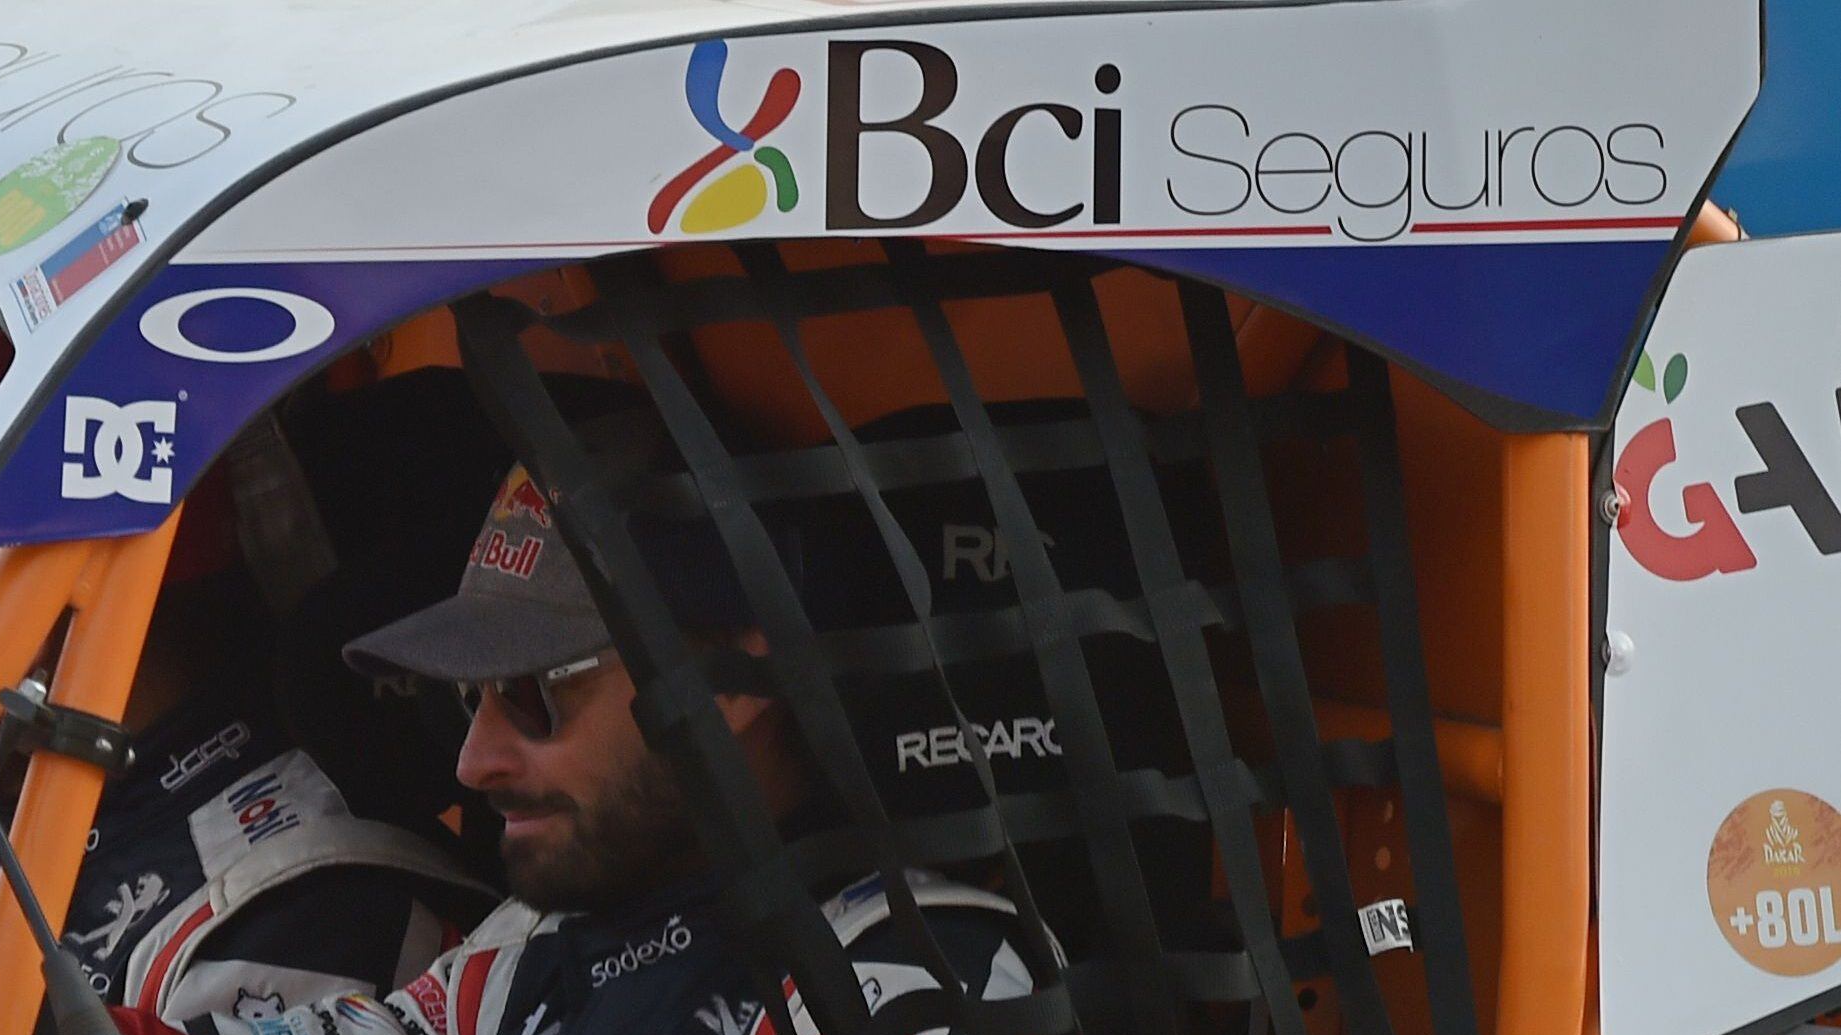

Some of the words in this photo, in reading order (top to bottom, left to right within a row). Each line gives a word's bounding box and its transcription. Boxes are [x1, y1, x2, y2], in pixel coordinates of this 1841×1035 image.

[826, 39, 1121, 230] Bci
[1167, 105, 1666, 242] Seguros
[61, 395, 177, 503] DC
[481, 530, 545, 581] Bull
[1763, 843, 1805, 864] DAKAR
[590, 925, 692, 988] sodexo
